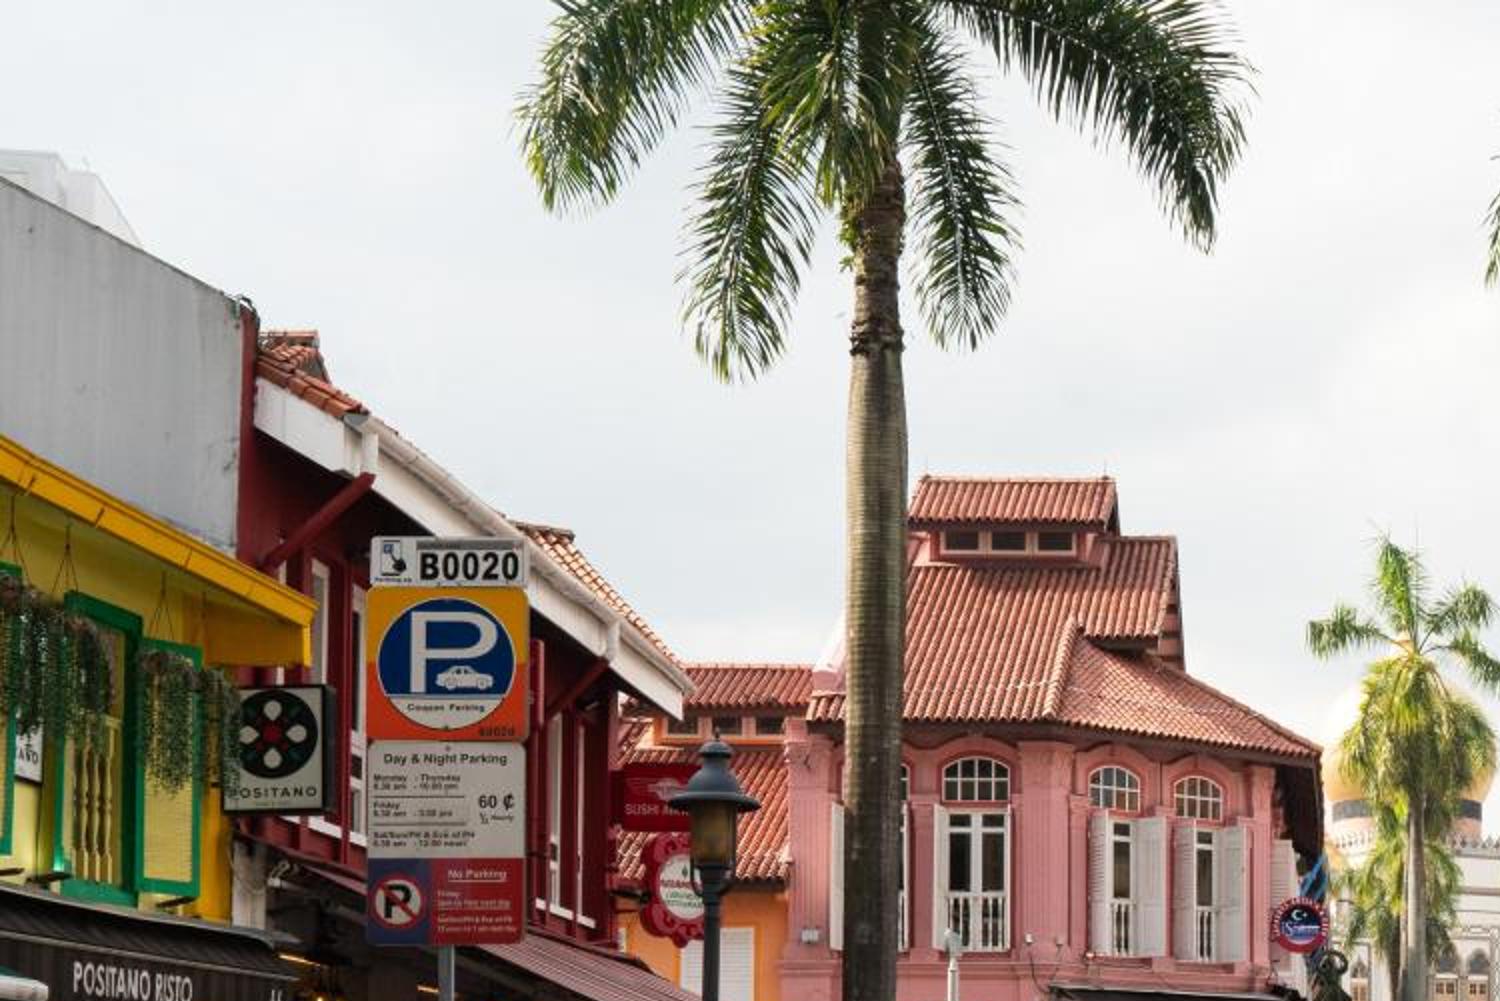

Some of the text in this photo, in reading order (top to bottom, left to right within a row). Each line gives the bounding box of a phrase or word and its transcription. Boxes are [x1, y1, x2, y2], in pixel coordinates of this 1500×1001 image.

[420, 552, 519, 580] B0020
[410, 611, 498, 693] P
[384, 754, 508, 766] Day & Night Parking
[479, 795, 497, 809] 60
[465, 870, 507, 881] Parking
[73, 961, 151, 1001] POSITANO
